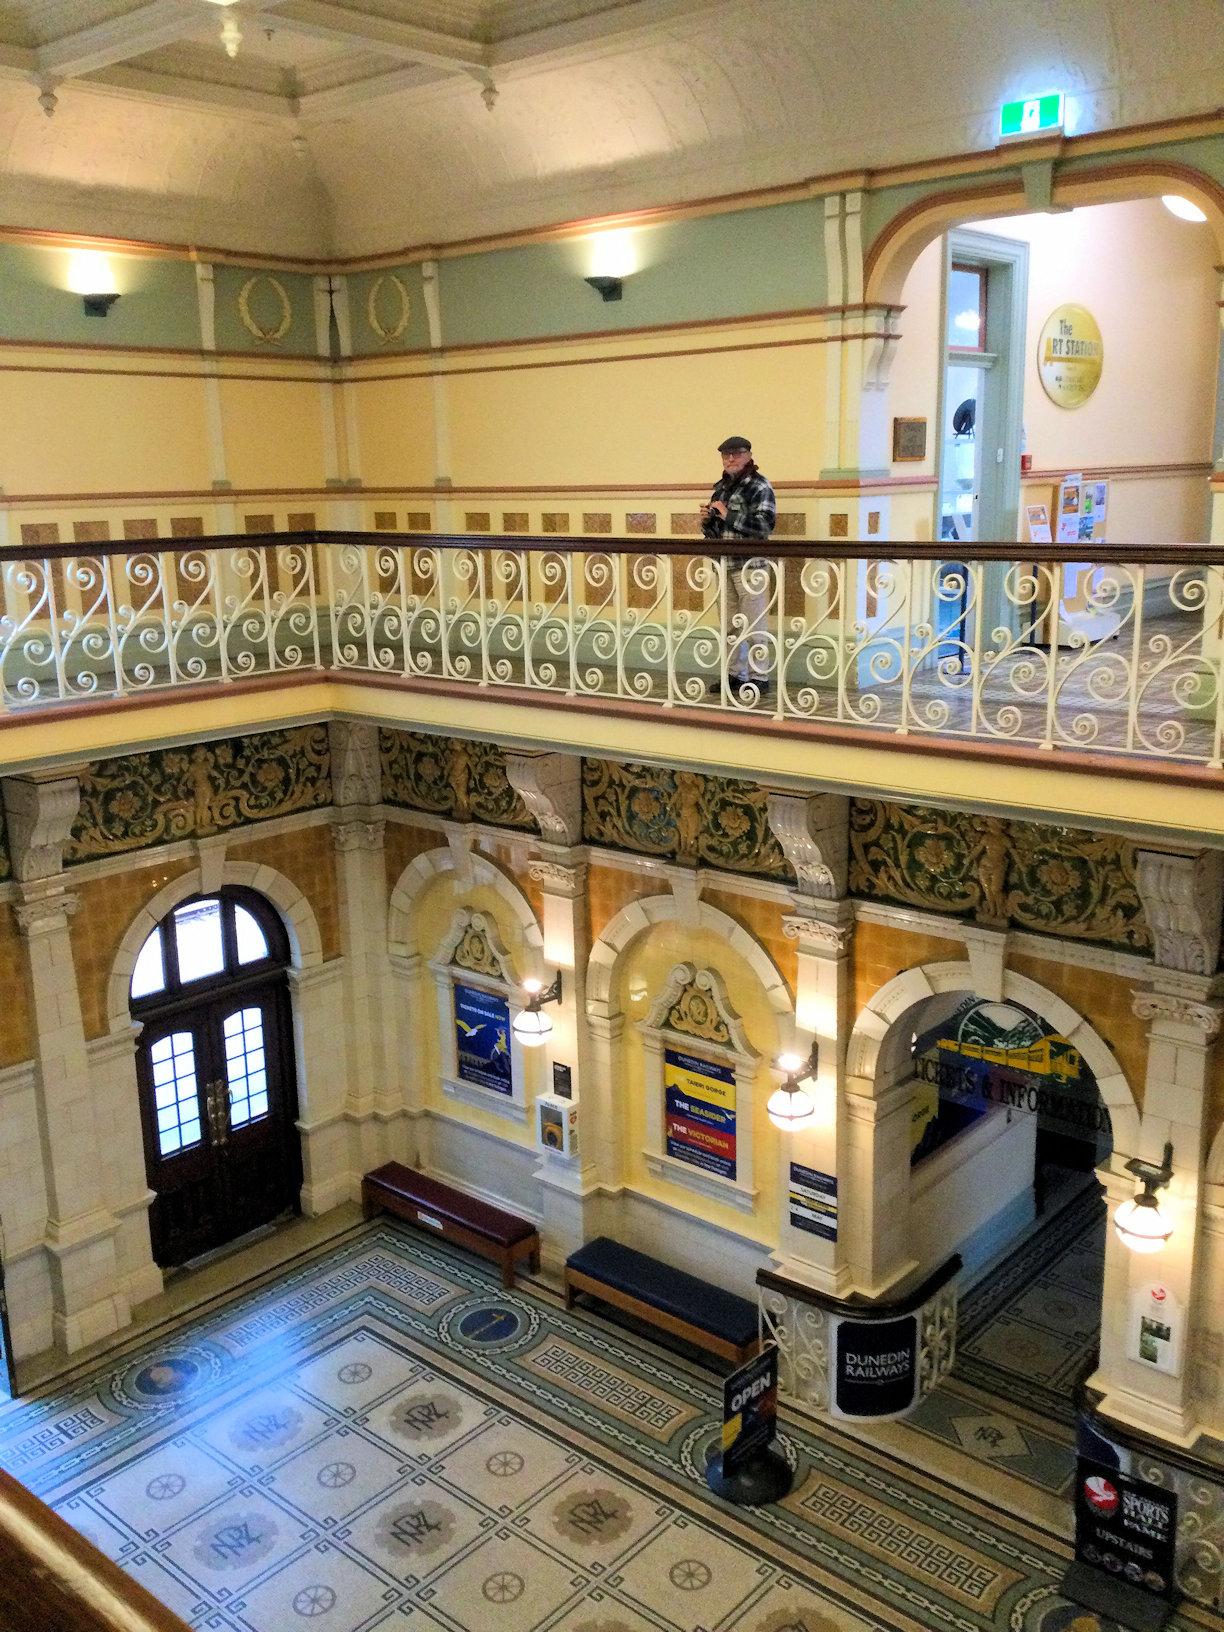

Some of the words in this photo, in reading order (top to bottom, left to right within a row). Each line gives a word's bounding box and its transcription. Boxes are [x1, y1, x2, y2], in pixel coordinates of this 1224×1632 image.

[1059, 318, 1073, 336] The
[1065, 339, 1101, 358] STATION
[674, 1099, 690, 1112] THE
[672, 1122, 688, 1135] THE
[687, 1128, 729, 1149] VICTORIAN
[846, 1348, 910, 1366] DUNEDIN
[846, 1360, 910, 1378] RAILWAYS
[731, 1372, 771, 1412] OPEN
